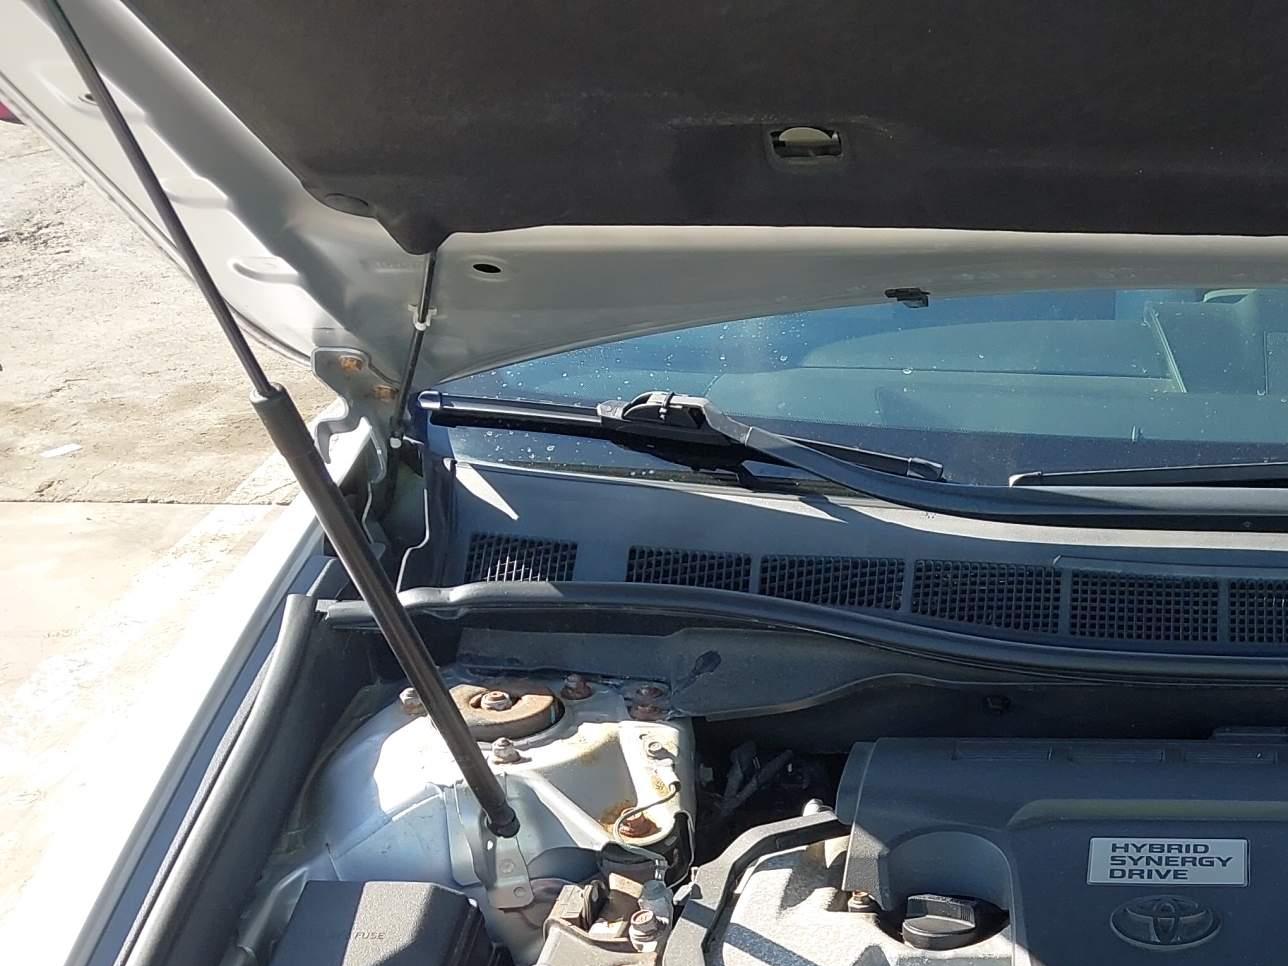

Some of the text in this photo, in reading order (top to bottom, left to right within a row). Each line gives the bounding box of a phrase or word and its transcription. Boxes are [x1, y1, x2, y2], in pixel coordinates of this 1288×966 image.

[1111, 843, 1210, 854] HYBRID
[1109, 855, 1233, 867] SYNERGY
[1108, 868, 1189, 880] DRIVE
[354, 931, 386, 940] FUSE
